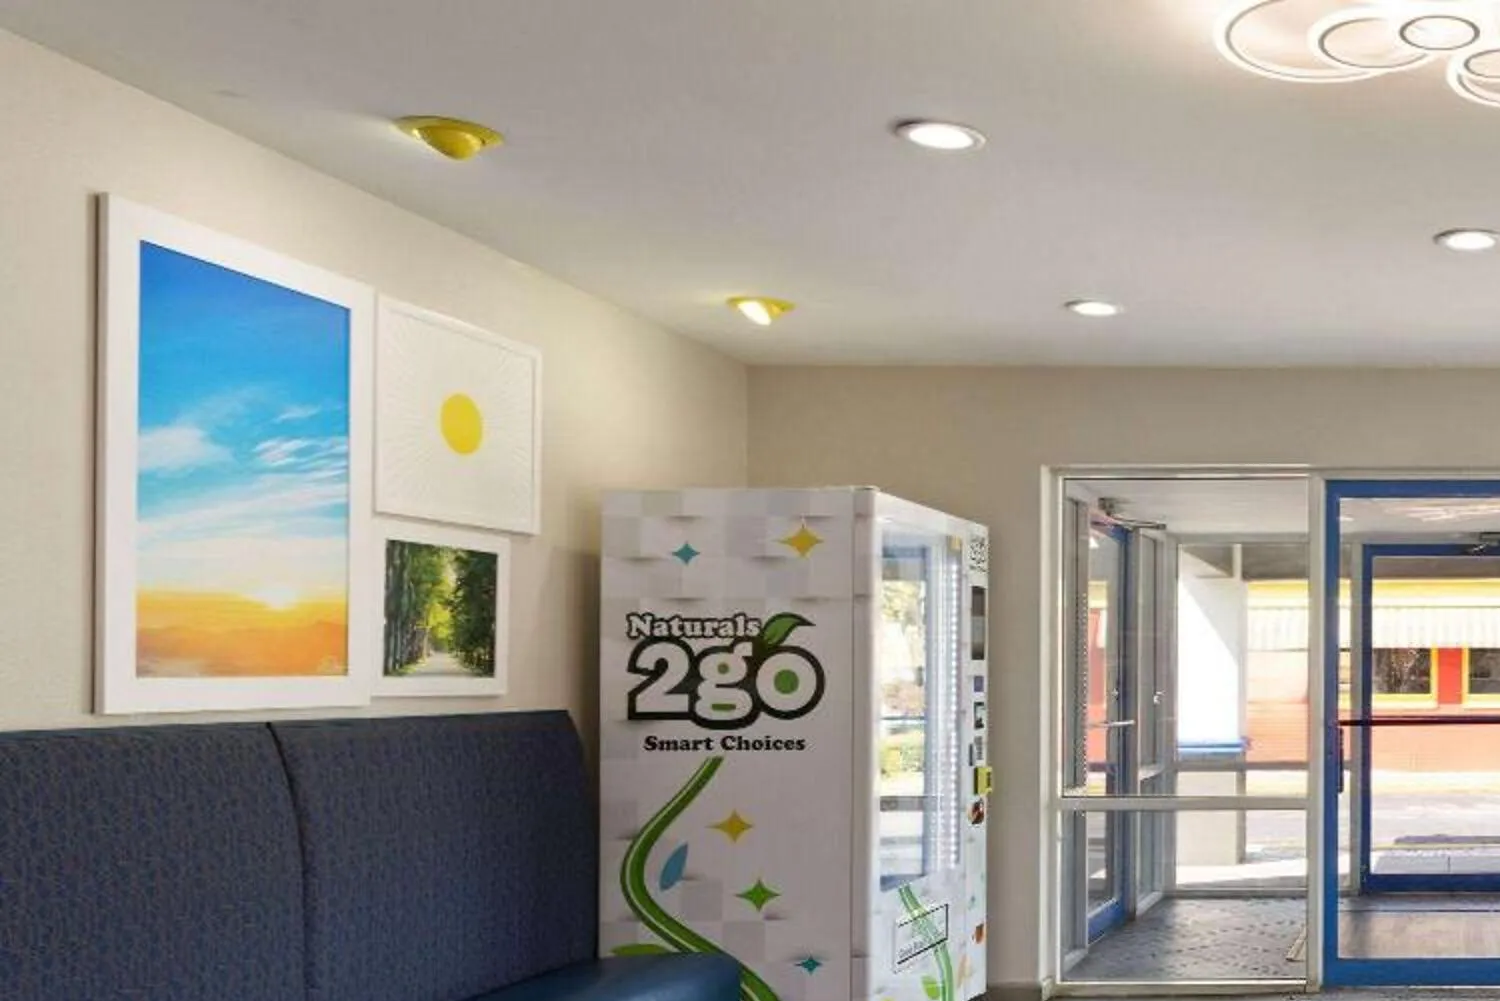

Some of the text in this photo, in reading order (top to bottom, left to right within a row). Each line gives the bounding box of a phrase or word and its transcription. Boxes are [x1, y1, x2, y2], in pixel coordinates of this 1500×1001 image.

[626, 612, 762, 640] Naturals
[627, 638, 826, 730] 2go
[643, 735, 806, 751] Smart Choices
